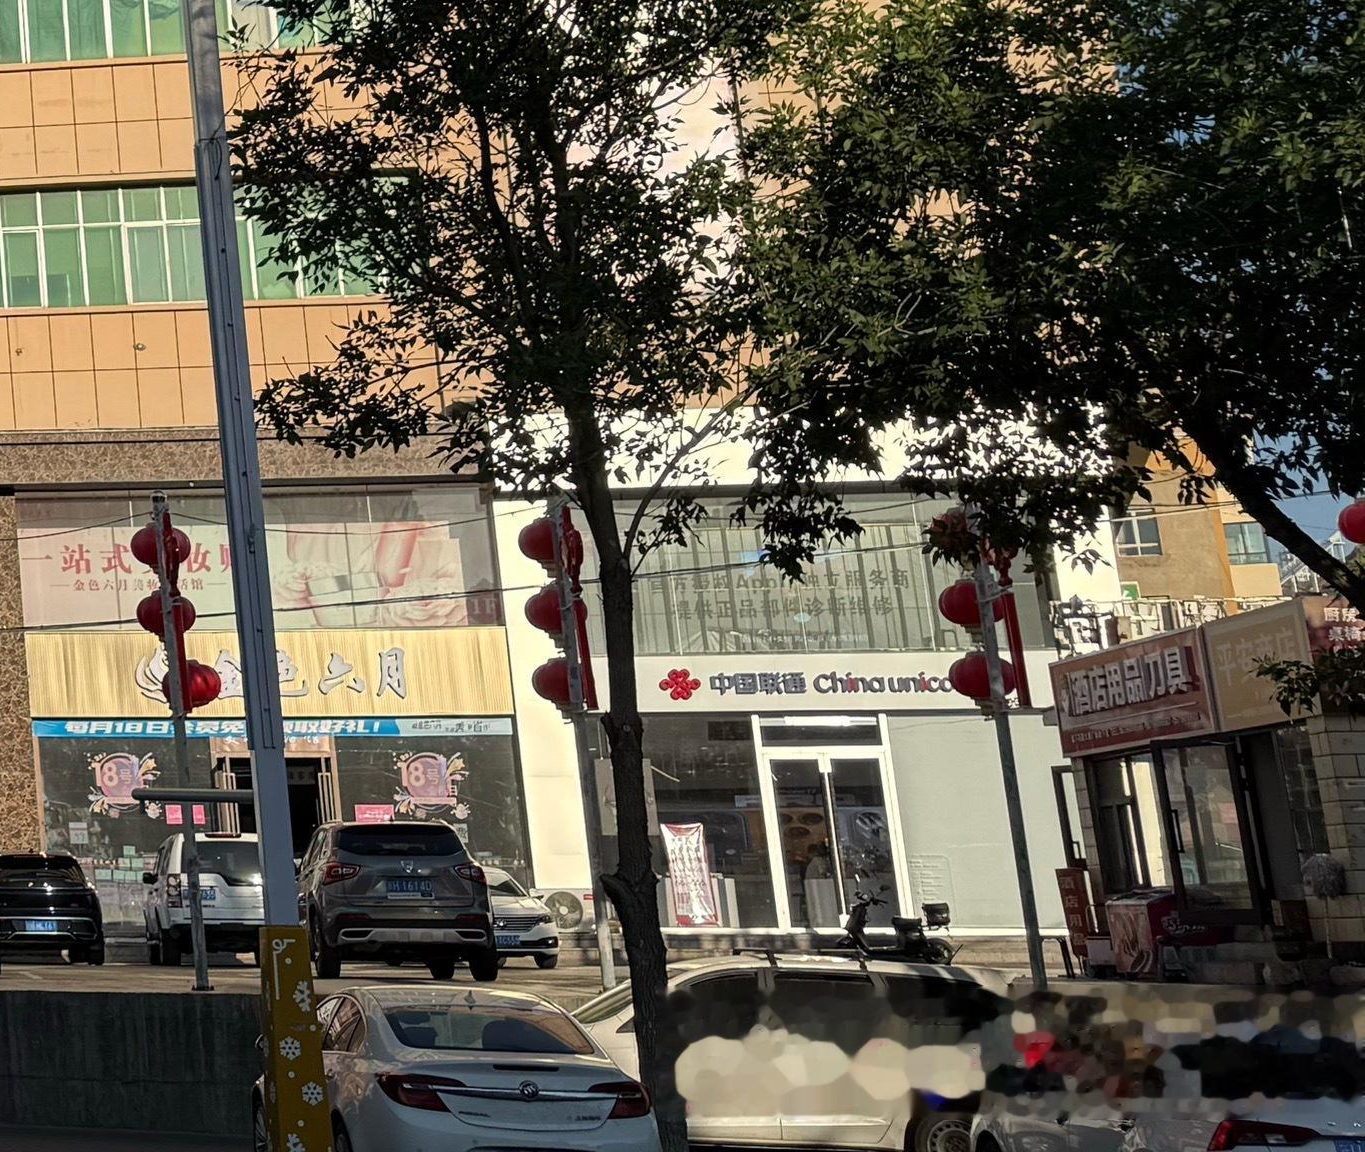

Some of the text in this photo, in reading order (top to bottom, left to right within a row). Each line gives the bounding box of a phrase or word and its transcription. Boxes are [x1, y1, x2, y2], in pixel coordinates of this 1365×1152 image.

[21, 542, 232, 575] 一站式妆
[73, 578, 204, 592] 金色六月美妆活馆
[709, 672, 807, 695] 中国联通
[888, 672, 955, 693] unico
